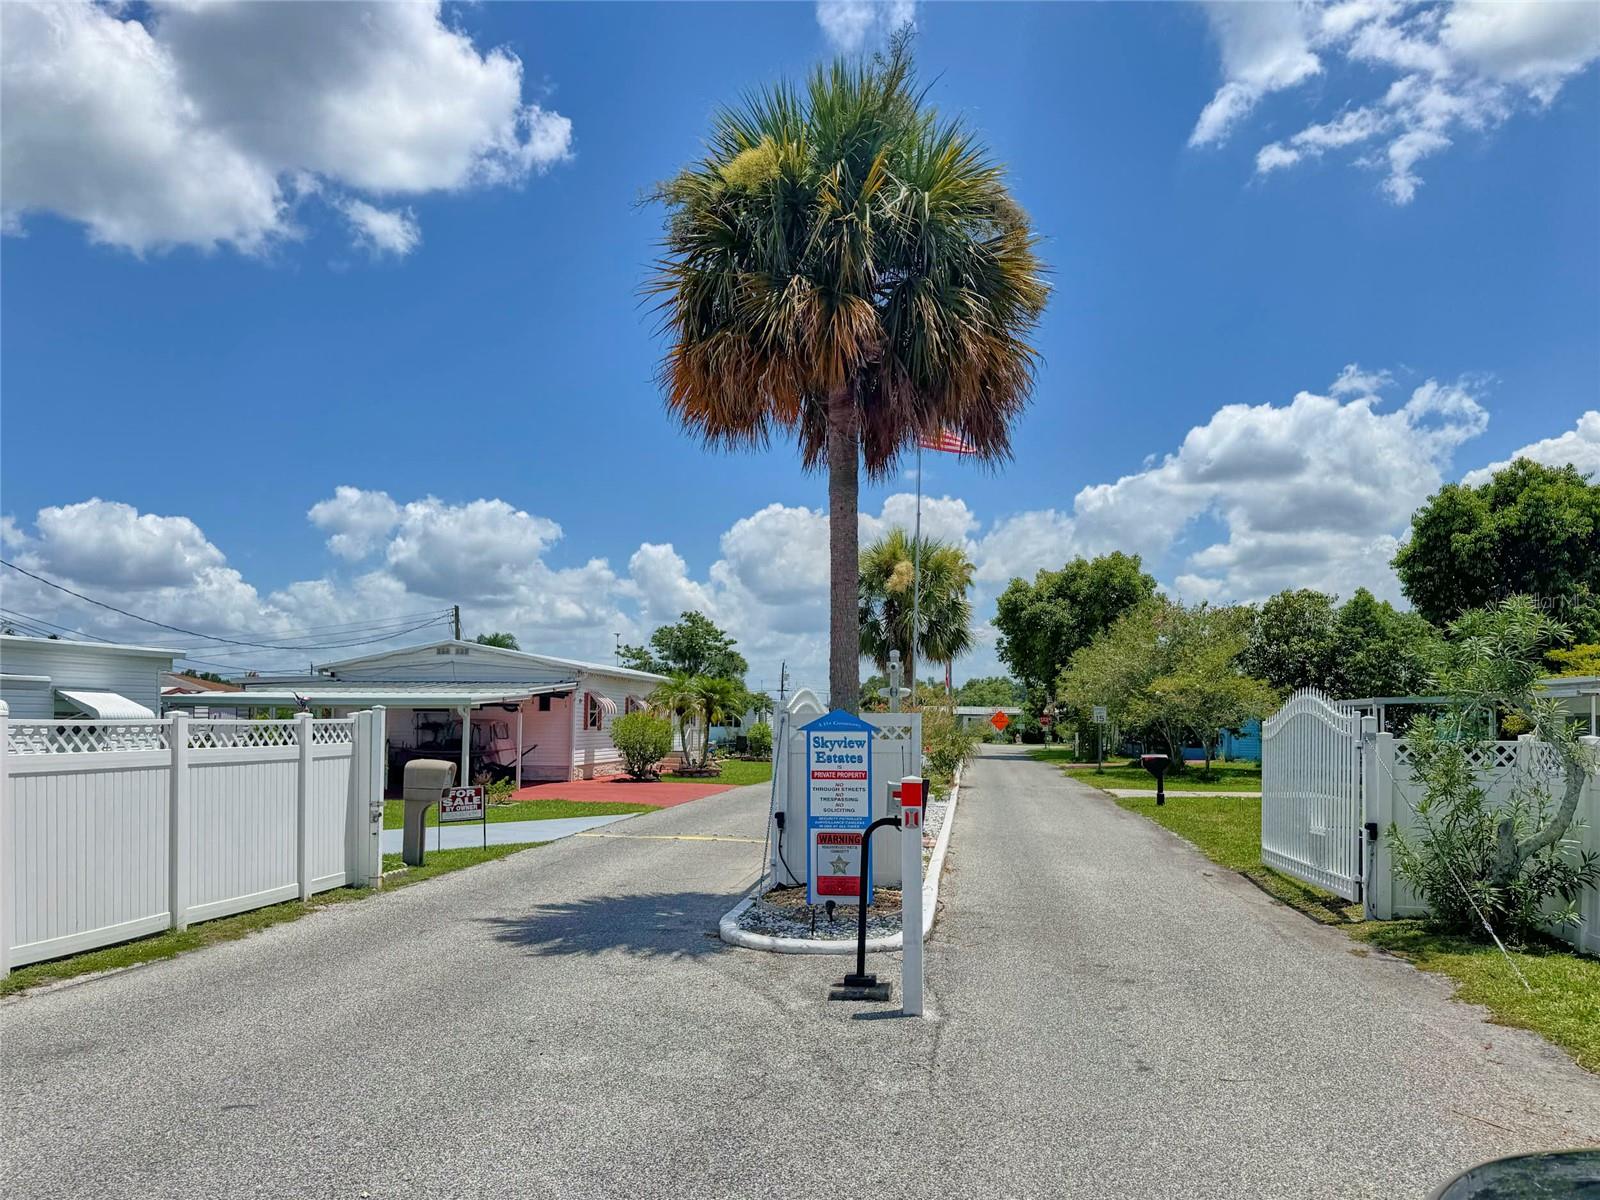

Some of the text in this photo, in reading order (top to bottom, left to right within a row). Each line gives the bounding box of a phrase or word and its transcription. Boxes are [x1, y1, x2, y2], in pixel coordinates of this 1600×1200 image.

[813, 736, 866, 752] Skyview
[815, 751, 863, 763] Estates
[449, 790, 476, 798] FOR
[443, 796, 480, 807] SALE
[819, 835, 860, 844] WARNING
